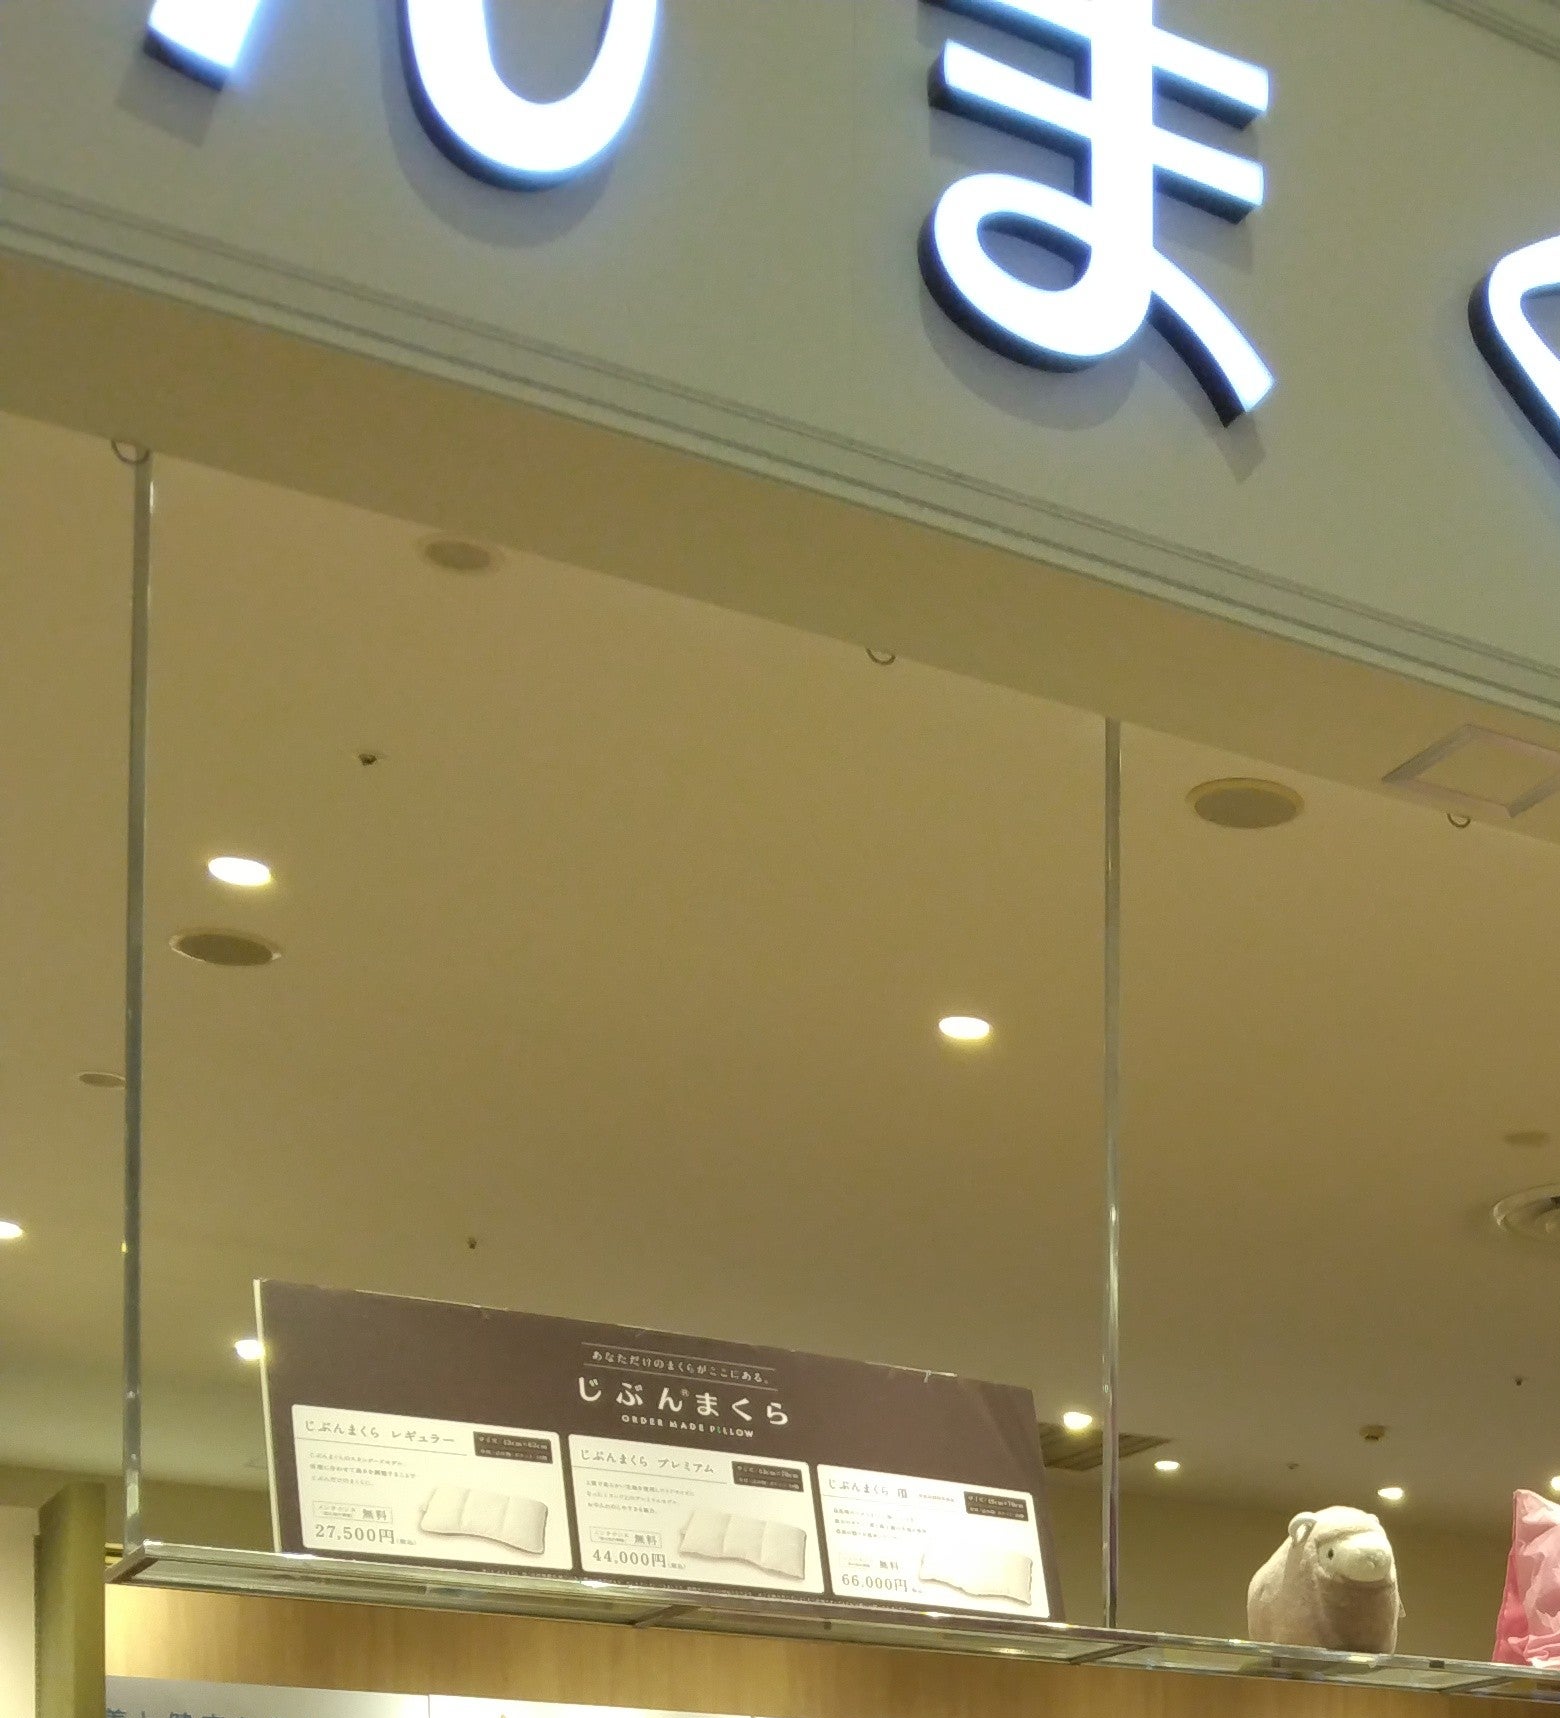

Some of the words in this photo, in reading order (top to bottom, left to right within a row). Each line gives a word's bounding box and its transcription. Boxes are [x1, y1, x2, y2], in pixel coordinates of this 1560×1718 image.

[592, 1350, 770, 1385] あなただけのまくらがここにある。
[304, 1420, 380, 1439] じぶんまくら
[391, 1429, 456, 1445] レギュラー
[621, 1414, 663, 1427] ORDER
[669, 1420, 705, 1433] MADE
[709, 1425, 754, 1438] PILLOW
[580, 1449, 649, 1468] じぶんまくら
[657, 1457, 715, 1475] プレミアム
[361, 1508, 388, 1522] 無料
[314, 1523, 396, 1544] 27,500円
[633, 1534, 658, 1547] 無料
[591, 1548, 667, 1569] 44,000円
